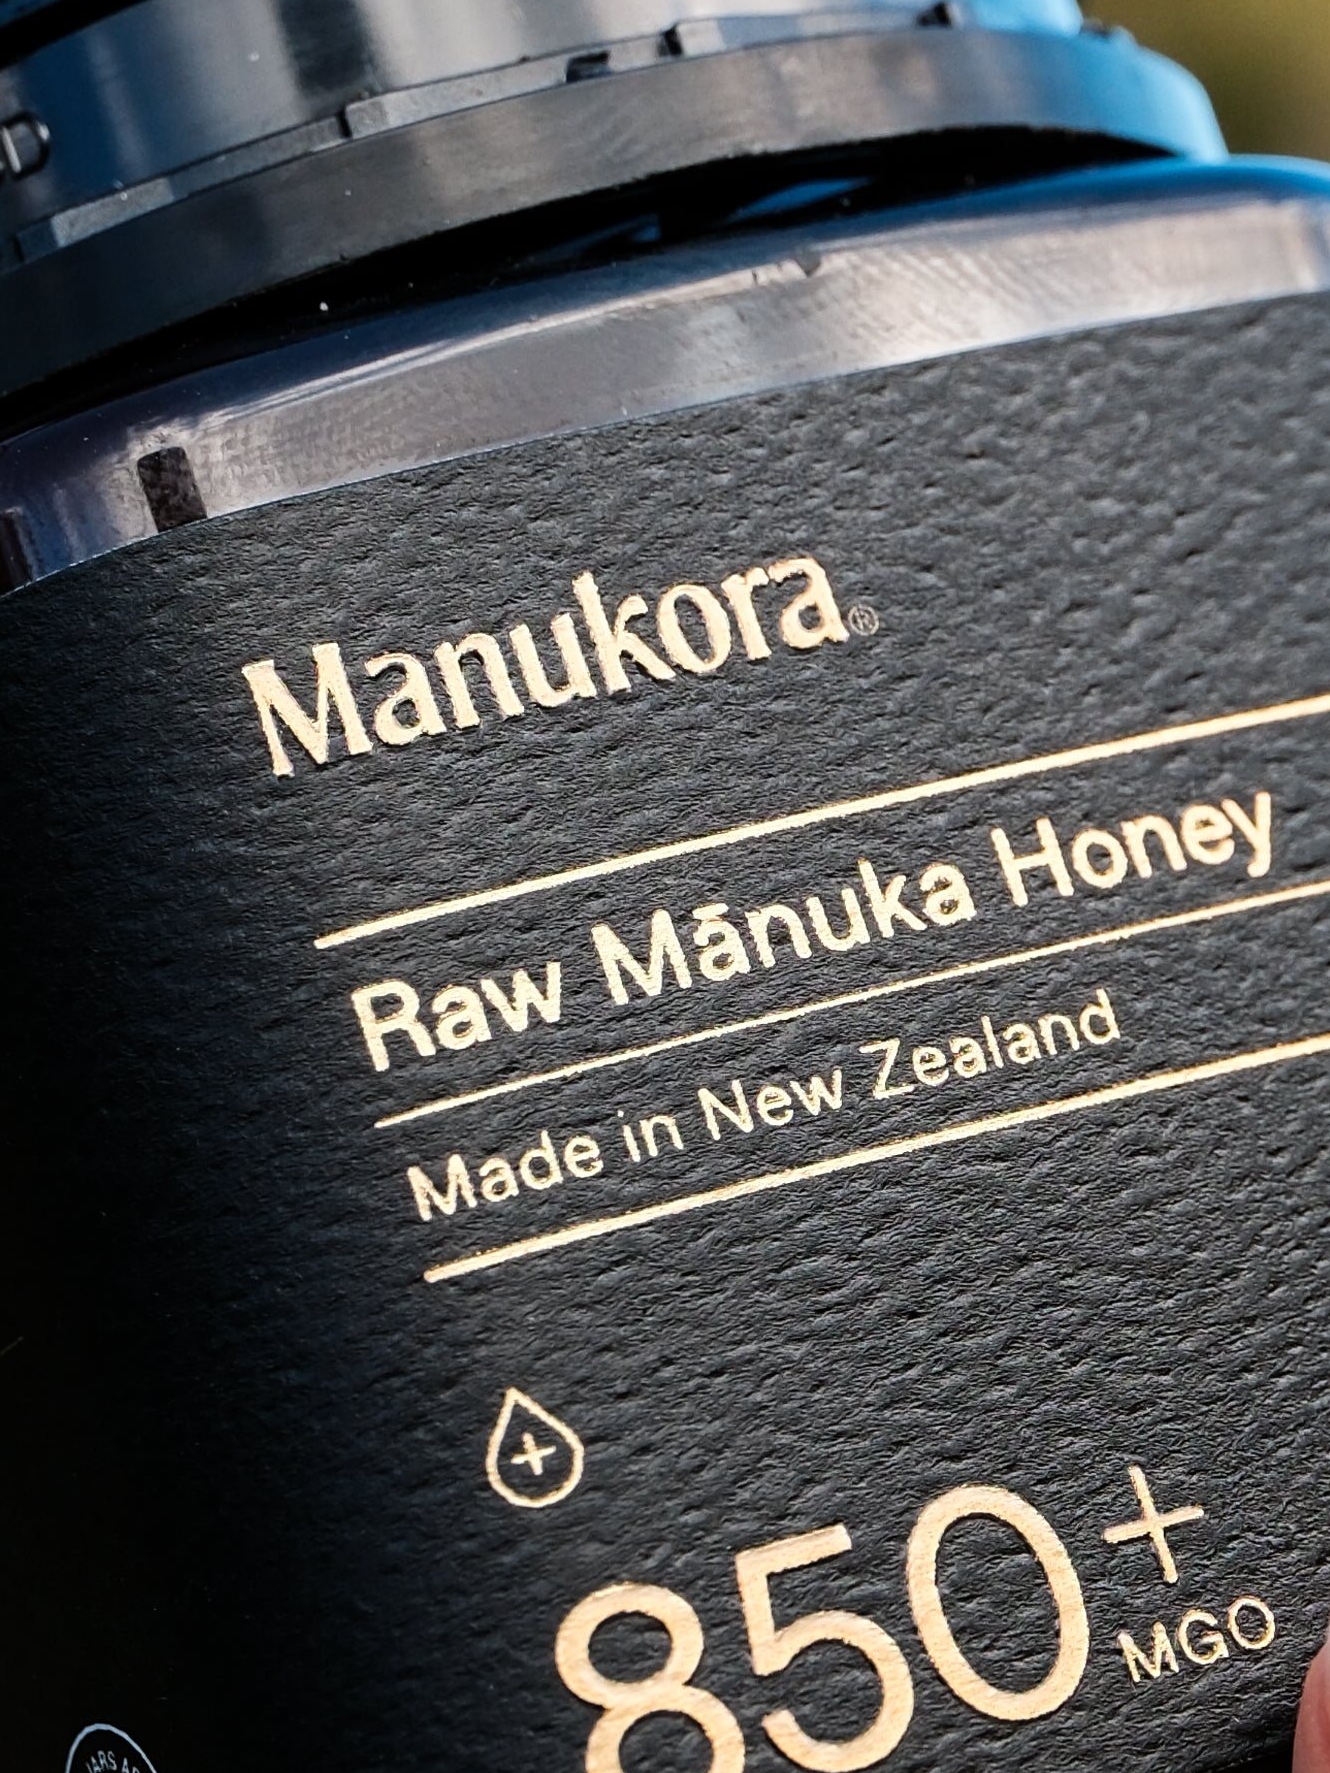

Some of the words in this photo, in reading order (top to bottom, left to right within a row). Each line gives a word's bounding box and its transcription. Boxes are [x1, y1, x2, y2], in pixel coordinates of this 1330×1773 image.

[350, 958, 562, 1072] Raw
[591, 857, 975, 1013] Mānuka
[989, 790, 1273, 909] Honey
[406, 1130, 603, 1222] Made
[622, 1108, 680, 1163] in
[696, 1069, 844, 1143] New
[860, 987, 1120, 1103] Zealand
[1117, 1594, 1277, 1686] MGO
